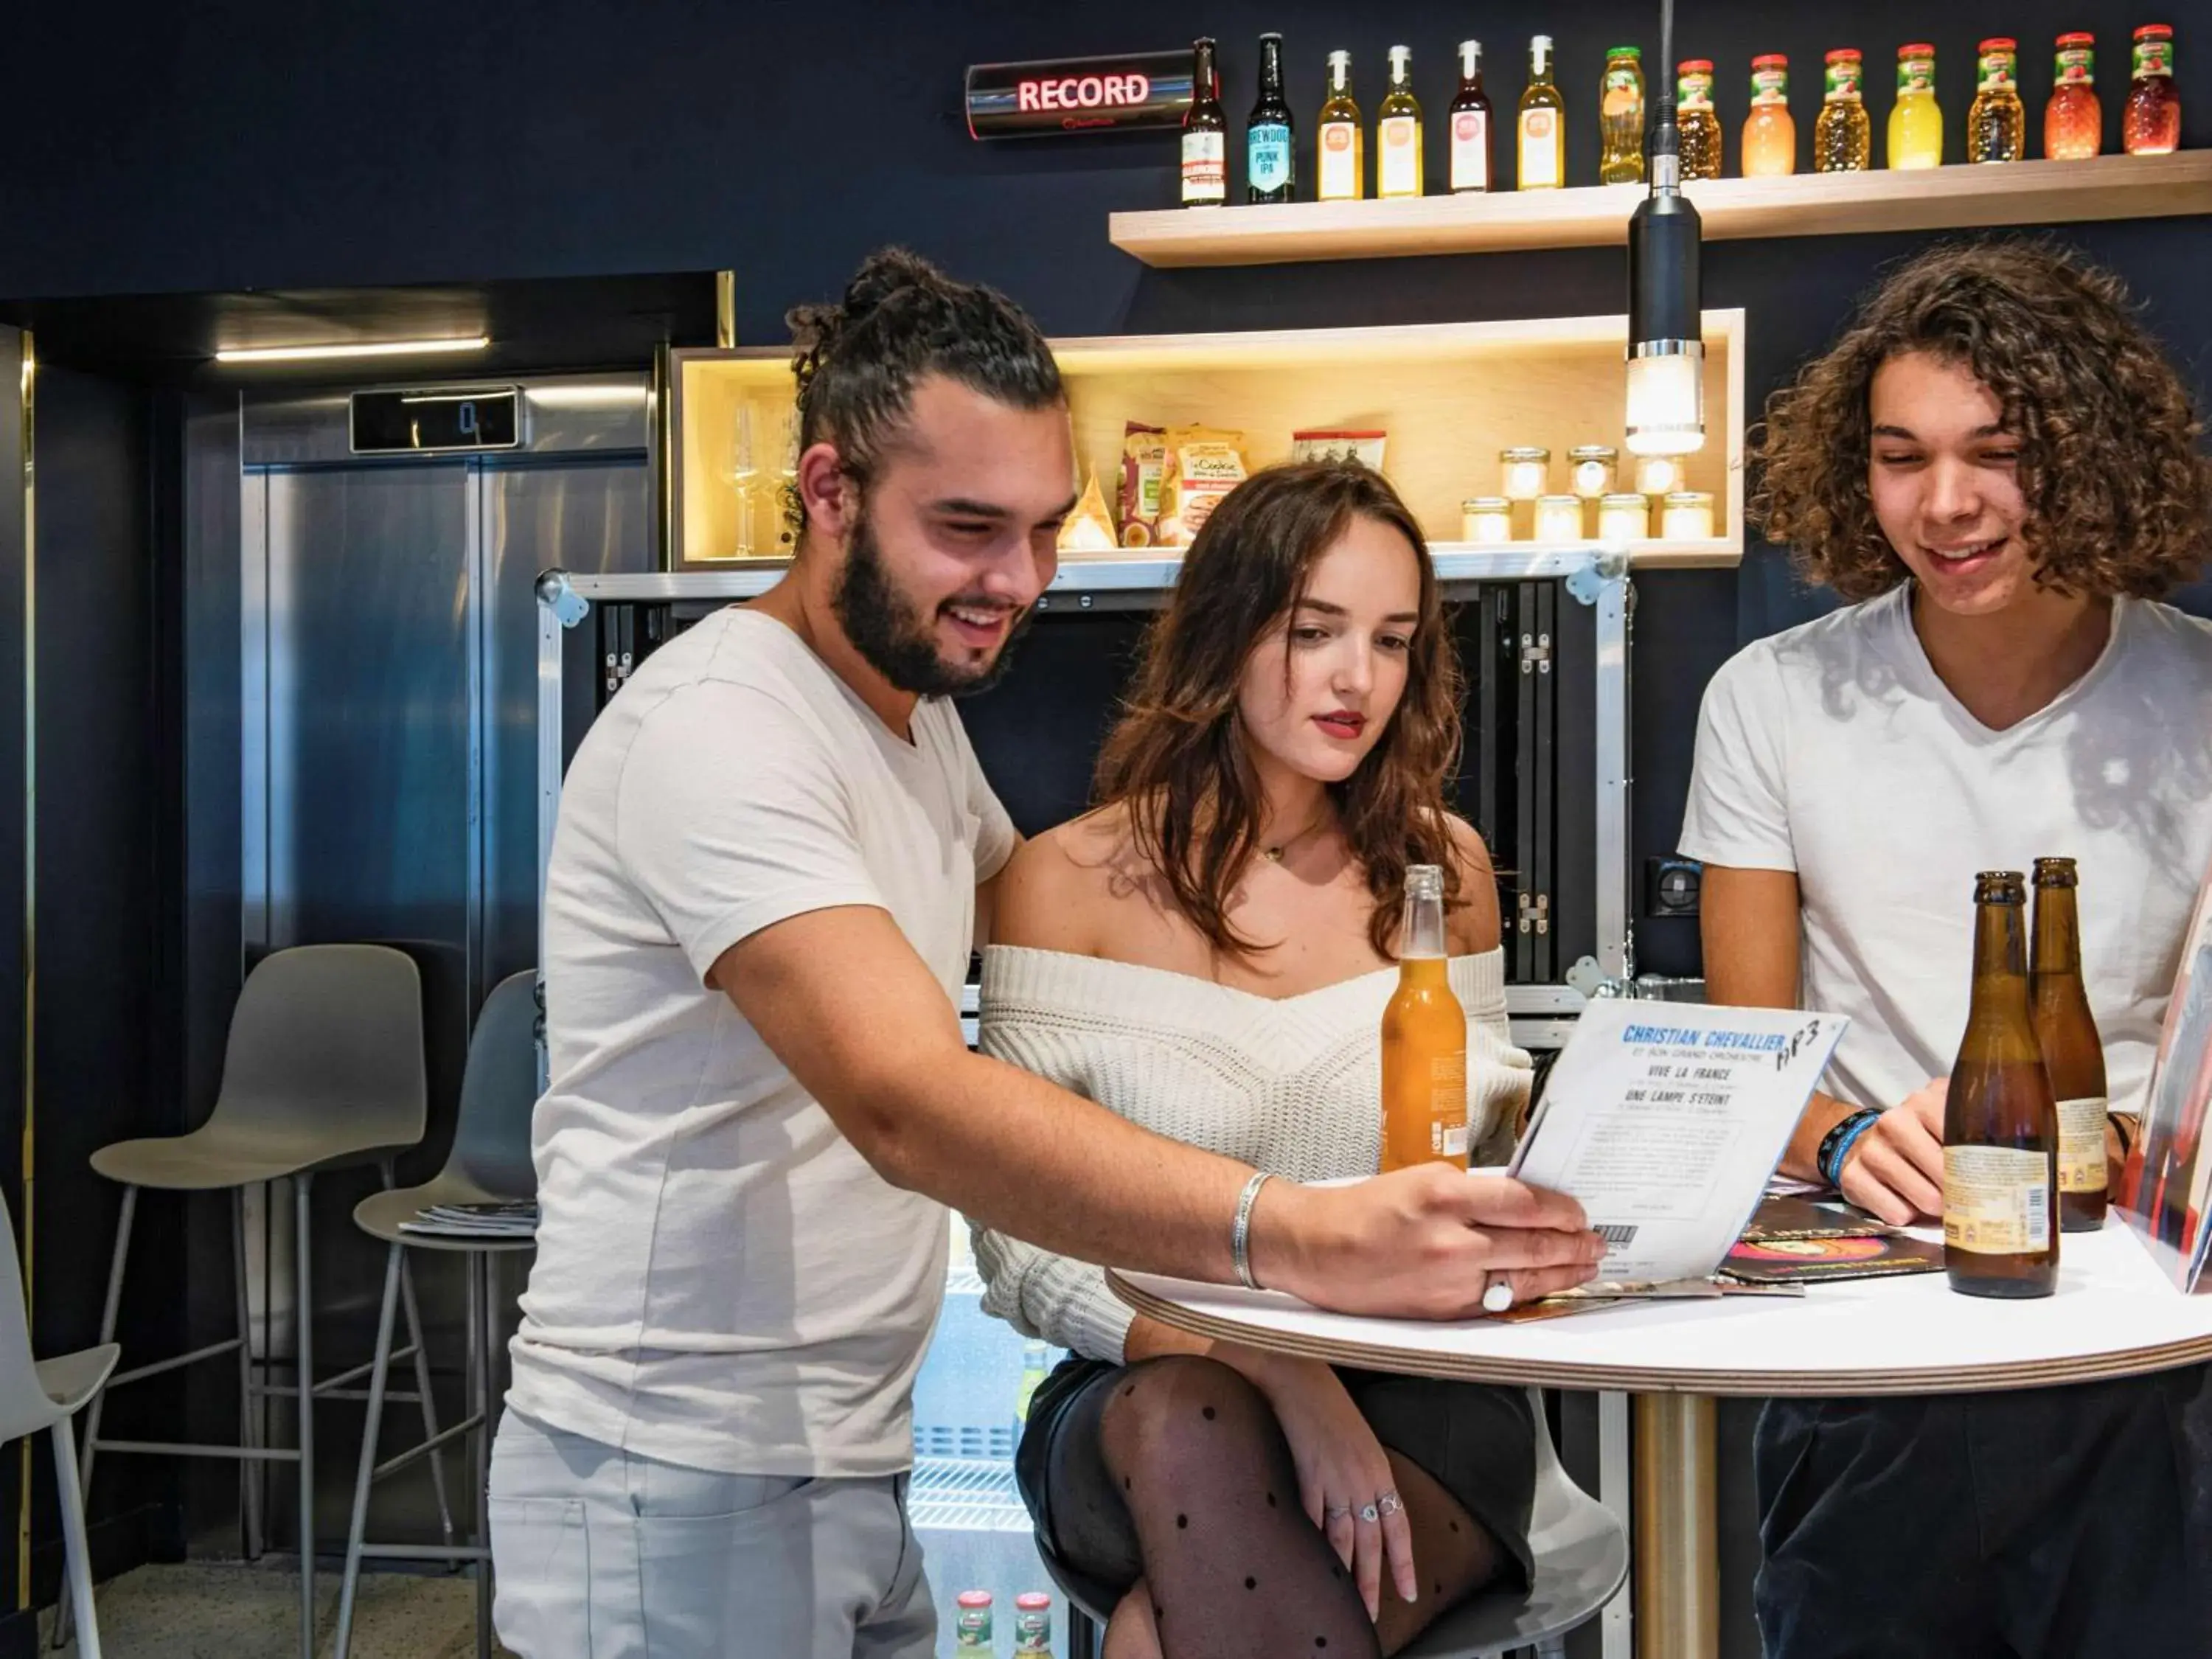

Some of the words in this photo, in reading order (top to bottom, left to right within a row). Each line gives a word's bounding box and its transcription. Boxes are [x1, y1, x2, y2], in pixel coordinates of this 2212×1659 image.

[1019, 74, 1150, 111] RECORD
[1256, 152, 1279, 163] PUNK
[1260, 163, 1274, 174] IPA
[1623, 1024, 1702, 1046] CHRISTIAN
[1705, 1029, 1787, 1051] CHEVALLIER
[1648, 1064, 1672, 1077] VIVE
[1674, 1065, 1688, 1078] LA
[1693, 1067, 1732, 1080] FRANCE
[1625, 1089, 1647, 1102] UNE
[1650, 1091, 1686, 1103] LAMPE
